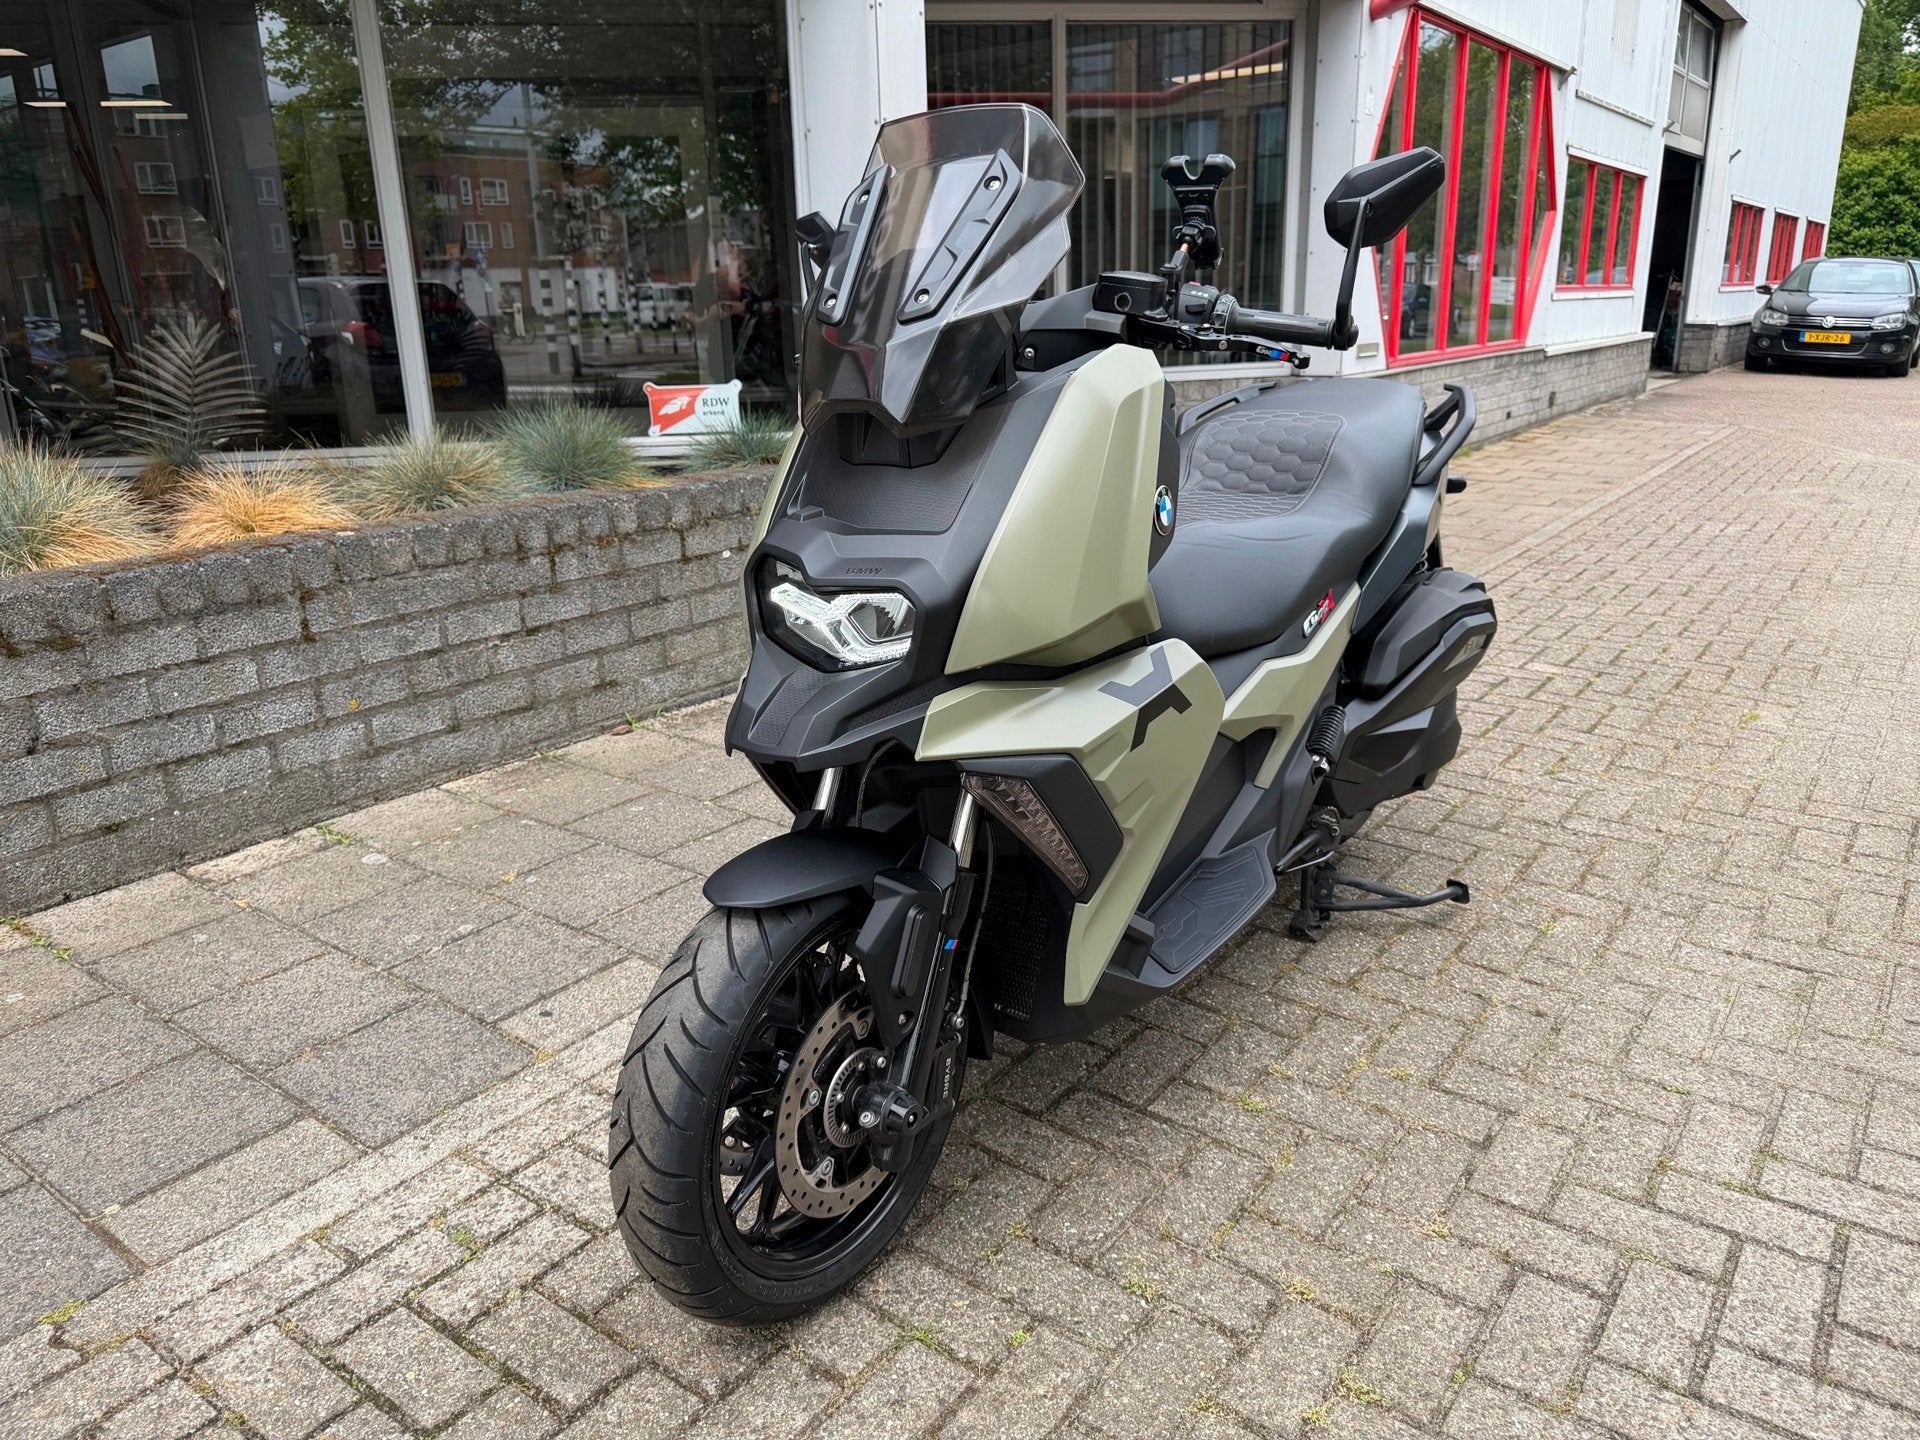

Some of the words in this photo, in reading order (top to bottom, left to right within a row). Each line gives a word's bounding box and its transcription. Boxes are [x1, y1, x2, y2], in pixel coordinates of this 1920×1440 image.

[1808, 333, 1846, 342] 1-XJR-26
[702, 397, 730, 407] RDW
[845, 567, 884, 575] BMW
[942, 1057, 952, 1100] BYBRE
